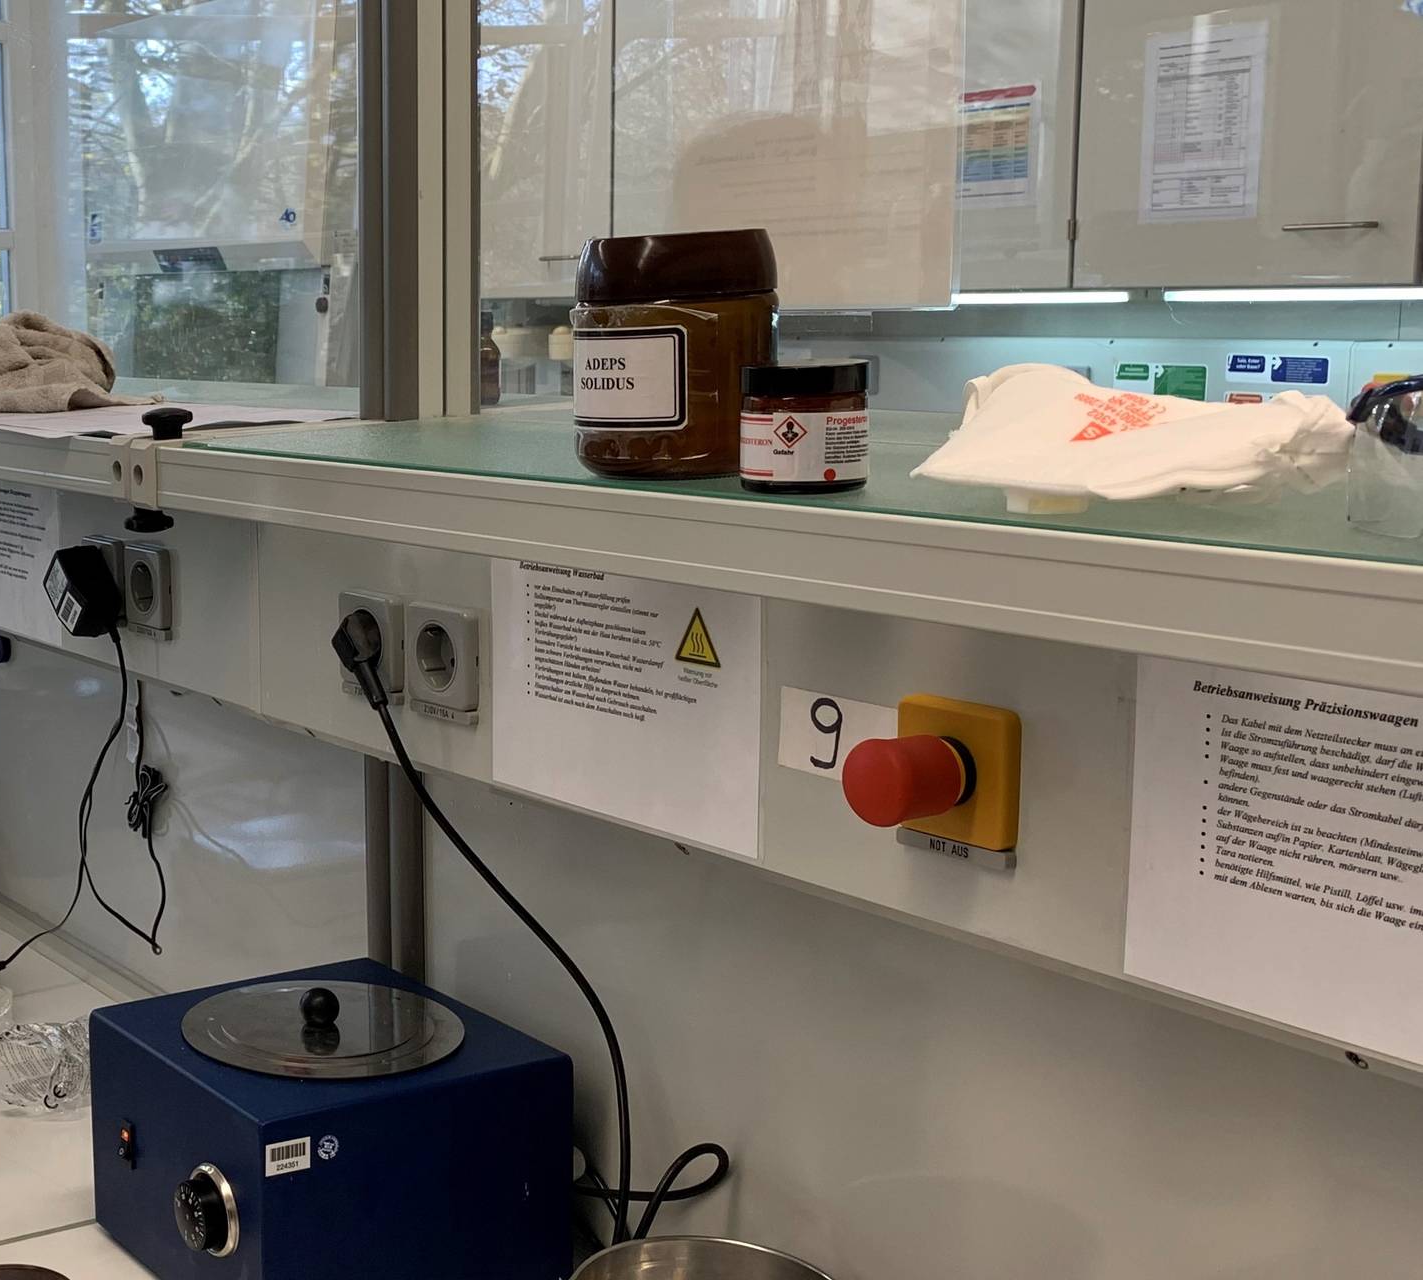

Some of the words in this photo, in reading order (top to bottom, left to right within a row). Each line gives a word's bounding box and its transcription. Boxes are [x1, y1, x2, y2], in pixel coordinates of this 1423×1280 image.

[581, 376, 635, 391] SOLIDUS
[585, 357, 626, 372] ADEPS
[573, 570, 604, 580] Wasserbad
[1193, 680, 1302, 711] Betriebsanweisung
[1304, 698, 1419, 728] Präzisionswaagen
[810, 697, 842, 769] 9
[1221, 714, 1238, 724] Das
[1241, 718, 1267, 730] Kabel
[1268, 724, 1282, 733] mit
[1284, 725, 1302, 736] dem
[1305, 728, 1372, 748] Netzteilstecker
[1374, 742, 1398, 753] muss
[1400, 747, 1413, 755] an
[1221, 728, 1232, 737] Ist
[1233, 730, 1247, 741] die
[1248, 732, 1317, 755] Stromzuführung
[1375, 756, 1397, 769] darf
[1397, 760, 1413, 770] die
[1220, 754, 1249, 769] Waage
[1251, 762, 1272, 772] muss
[1273, 765, 1290, 776] fest
[1291, 770, 1309, 780] und
[1311, 773, 1364, 787] waagerecht
[1365, 783, 1397, 797] stehen
[1221, 741, 1249, 756] Waage
[1251, 748, 1261, 756] so
[1263, 750, 1306, 766] aufstellen,
[1309, 758, 1330, 770] dass
[1332, 764, 1389, 780] unbehindert
[1218, 793, 1250, 807] können.
[1218, 782, 1248, 794] andere
[1249, 787, 1305, 806] Gegenstände
[1307, 800, 1328, 810] oder
[1330, 803, 1346, 815] das
[1348, 806, 1403, 826] Stromkabel
[1217, 807, 1232, 817] der
[1235, 810, 1289, 830] Wägebereich
[1291, 823, 1301, 832] ist
[1303, 827, 1314, 835] zu
[1316, 828, 1357, 845] beachten
[1217, 819, 1264, 838] Substanzen
[1265, 832, 1291, 844] auf/in
[930, 838, 946, 854] NOT
[952, 844, 969, 859] AUS
[1216, 846, 1236, 858] Tara
[1216, 834, 1232, 845] auf
[1232, 836, 1247, 847] der
[1249, 840, 1277, 855] Waage
[1279, 848, 1301, 860] nicht
[1303, 854, 1336, 869] rühren,
[1339, 862, 1378, 877] mörsern
[1214, 874, 1228, 883] mit
[1230, 876, 1248, 888] dem
[1249, 882, 1283, 897] Ablesen
[1285, 891, 1317, 906] warten,
[1320, 898, 1334, 909] bis
[1336, 904, 1355, 915] sich
[1357, 908, 1372, 918] die
[1375, 911, 1407, 928] Waage
[1215, 858, 1254, 876] benötigte
[1305, 881, 1321, 892] wie
[1356, 892, 1384, 907] Löffel
[1409, 905, 1423, 917] im
